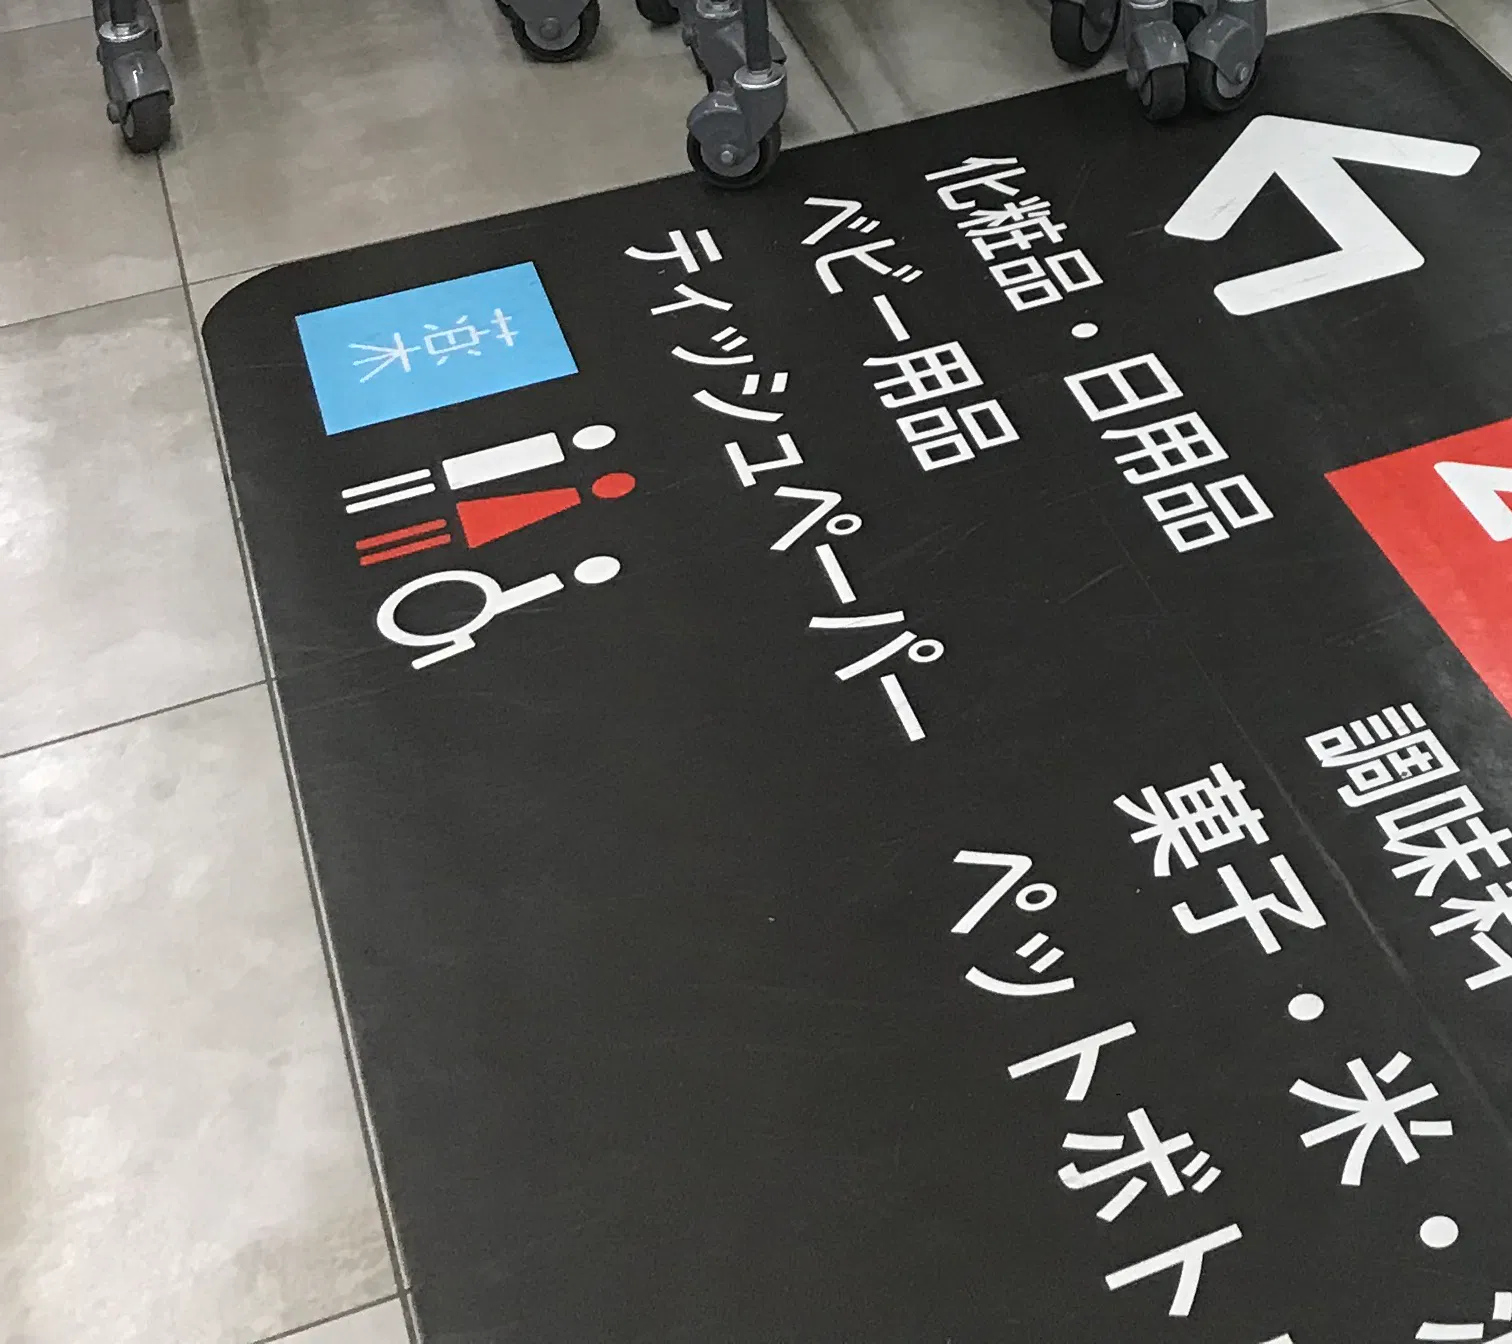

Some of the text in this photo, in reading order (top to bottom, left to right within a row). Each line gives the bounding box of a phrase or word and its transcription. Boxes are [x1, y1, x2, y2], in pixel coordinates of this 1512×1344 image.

[624, 228, 946, 743] ティッシュペーパー
[801, 195, 1021, 472] ベビー用品
[926, 152, 1275, 554] 化粧品・日用品
[953, 847, 1294, 1344] ペットボト
